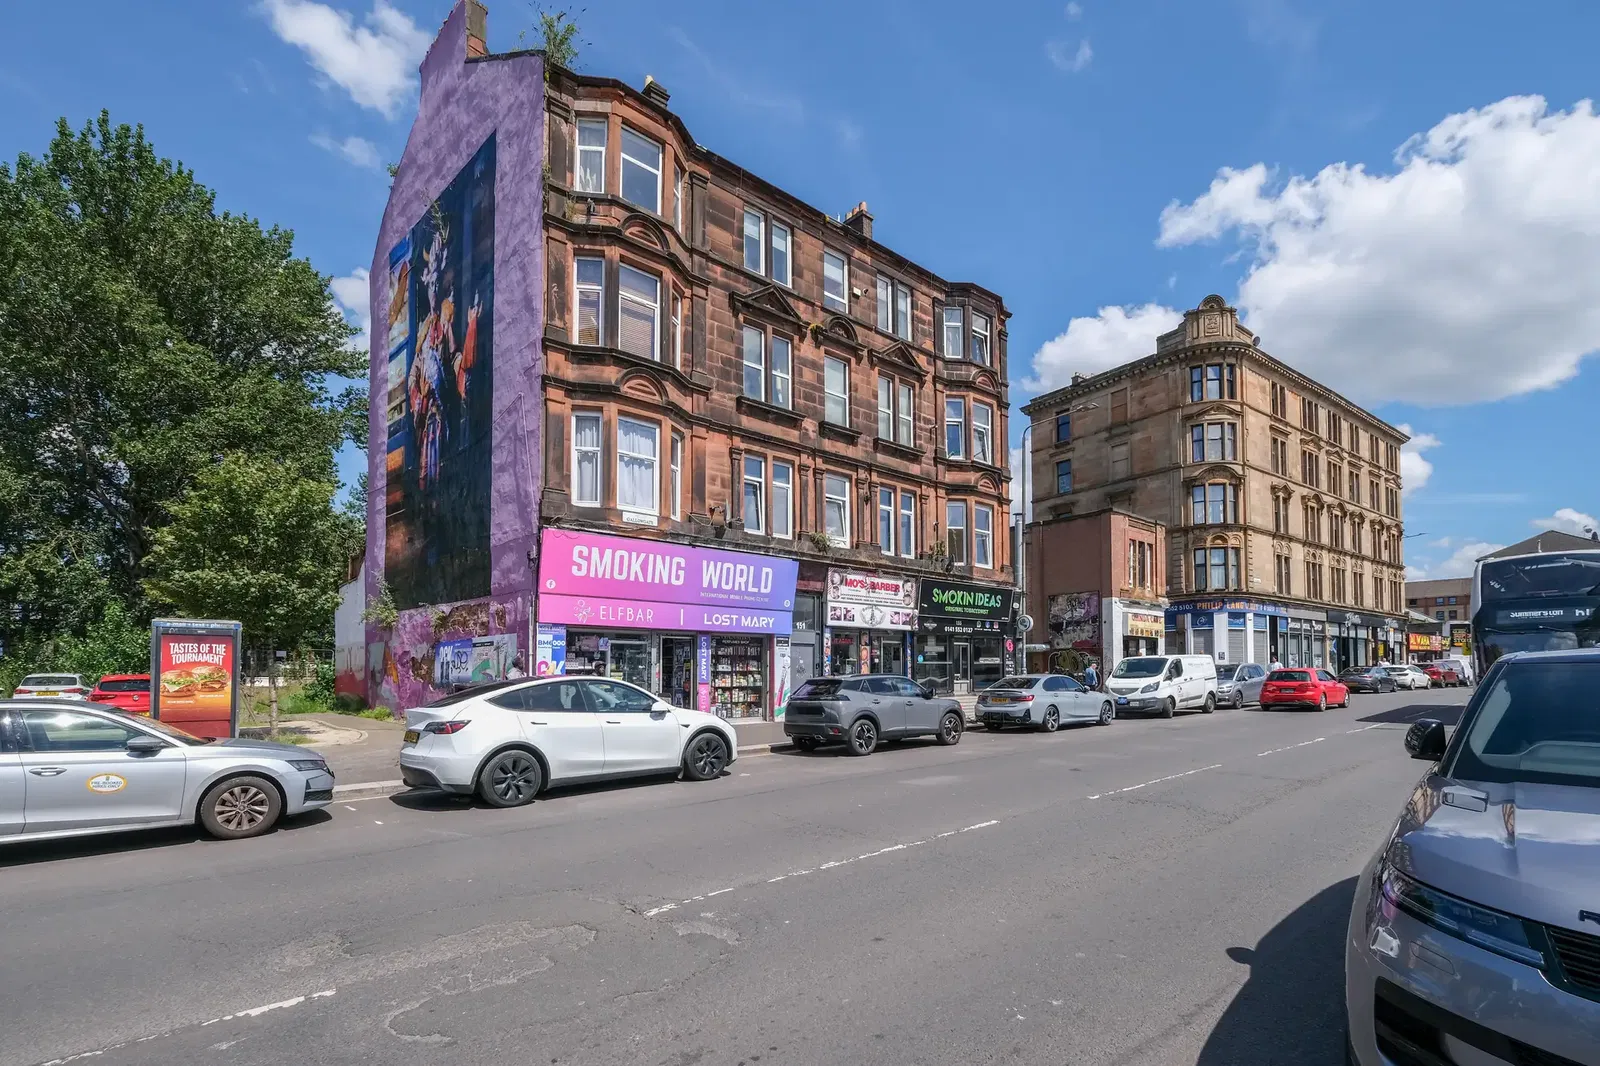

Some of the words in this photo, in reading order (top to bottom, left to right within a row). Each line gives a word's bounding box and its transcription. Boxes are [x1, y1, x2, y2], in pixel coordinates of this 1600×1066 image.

[571, 545, 686, 586] SMOKING
[702, 559, 773, 594] WORLD
[845, 578, 866, 589] MO'S
[869, 581, 901, 593] BARBER
[932, 588, 974, 606] SMOKIN
[975, 593, 1002, 608] IDEAS
[1196, 602, 1223, 610] PHILIP
[600, 606, 654, 622] ELFBAR
[704, 613, 738, 626] LOST
[741, 615, 775, 628] MARY
[169, 643, 198, 653] TASTES
[200, 643, 210, 653] OF
[212, 644, 226, 656] THE
[172, 652, 224, 666] TOURNAMENT
